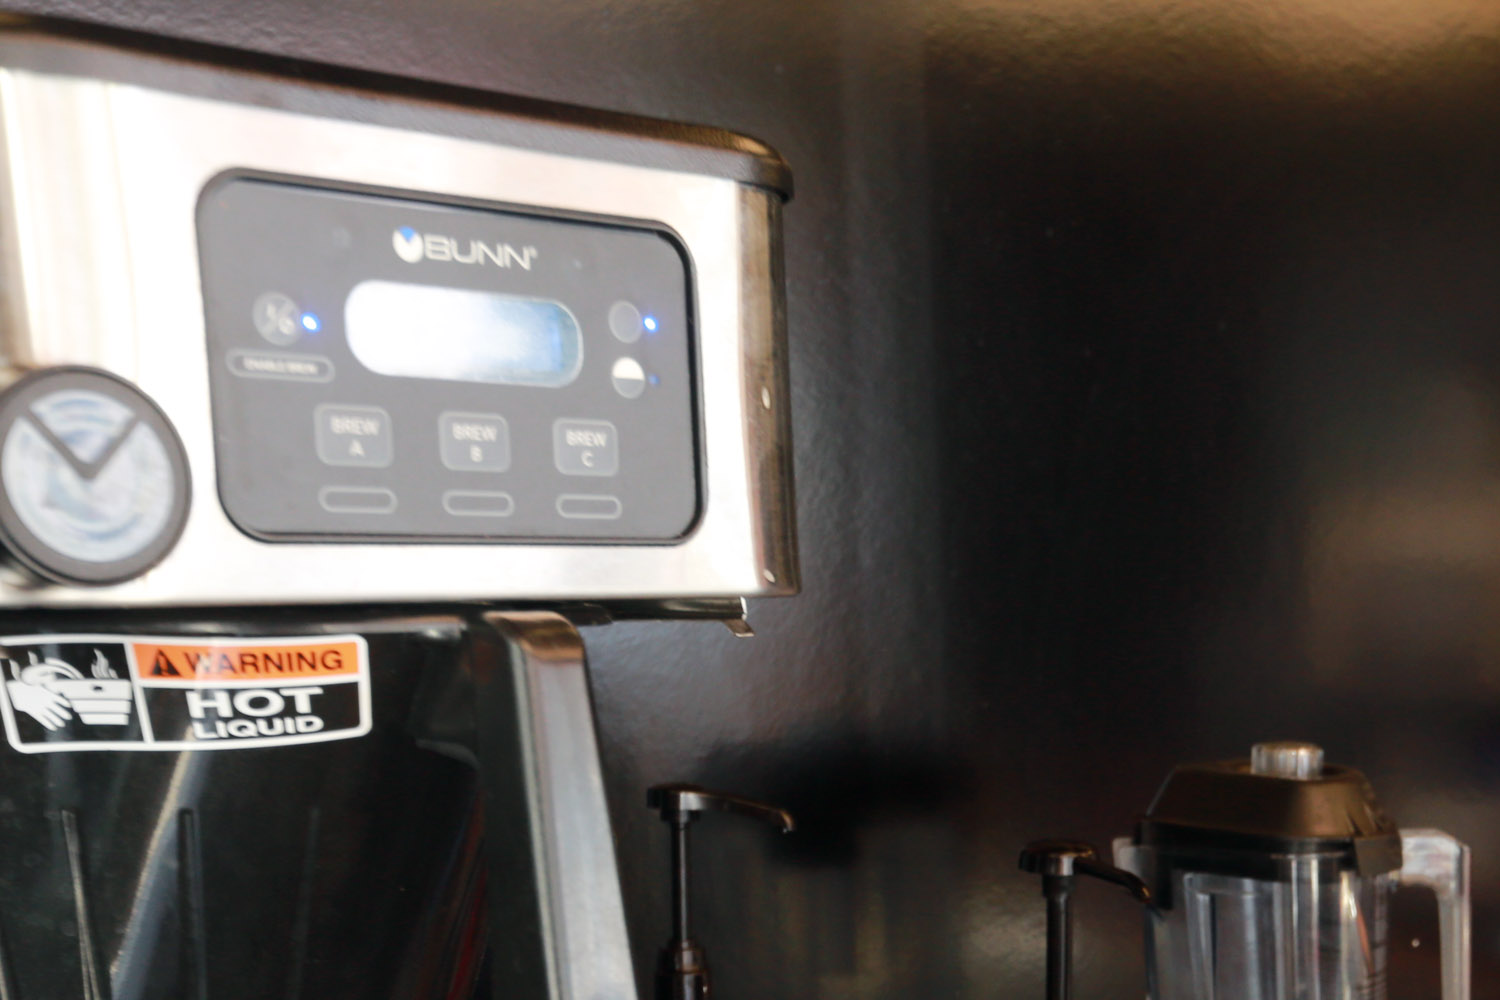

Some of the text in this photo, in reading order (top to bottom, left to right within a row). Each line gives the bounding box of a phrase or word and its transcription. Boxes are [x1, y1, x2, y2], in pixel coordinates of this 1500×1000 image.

[330, 416, 380, 435] BREW
[452, 423, 498, 442] BREW
[349, 439, 366, 457] A
[566, 429, 607, 448] BREW
[470, 444, 483, 463] B
[581, 450, 594, 468] C
[184, 650, 343, 674] WARNING
[185, 687, 324, 719] HOT
[191, 715, 325, 739] LIQUID
